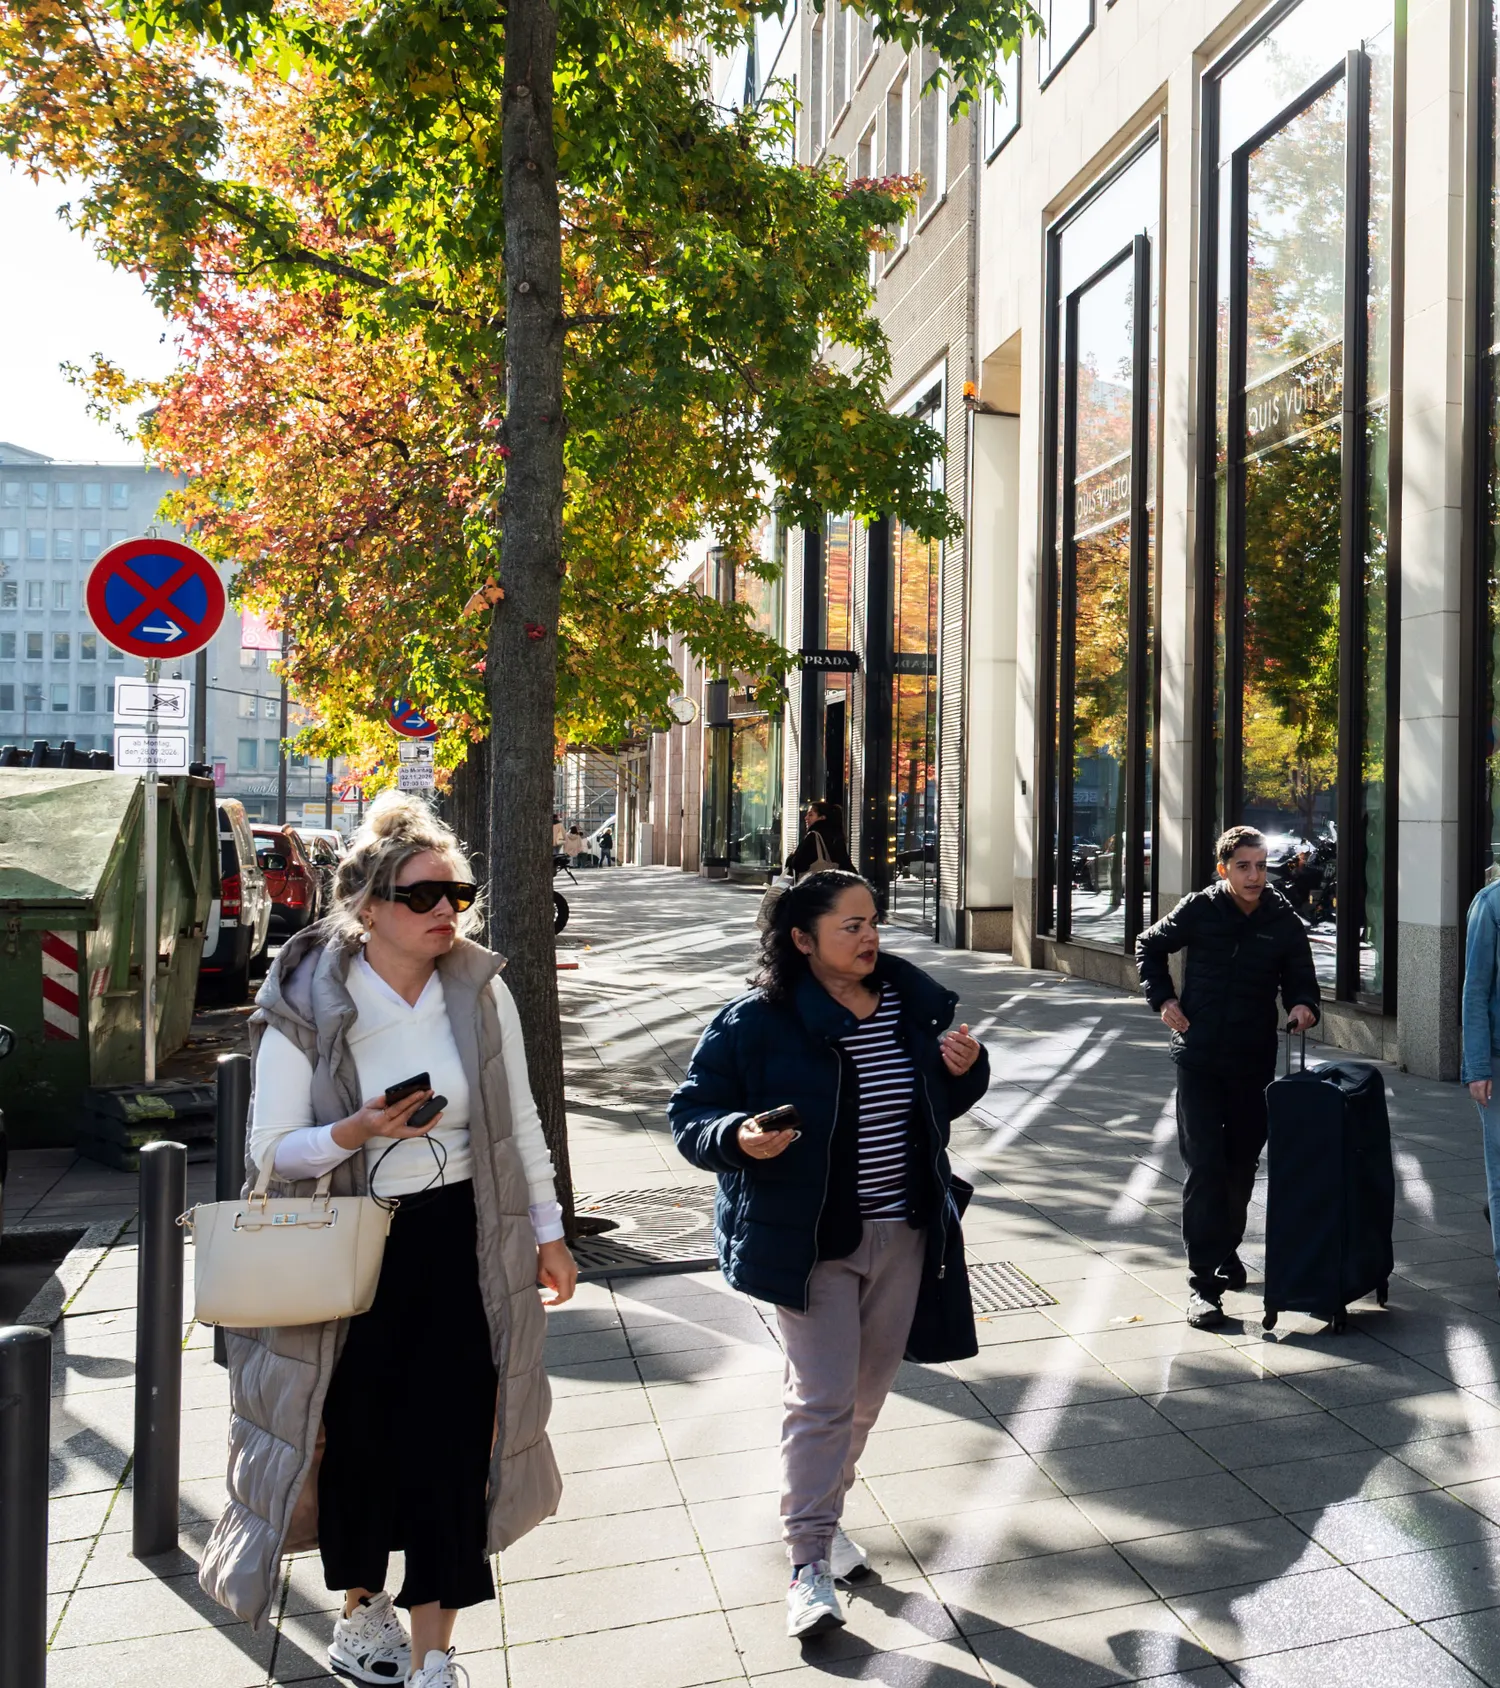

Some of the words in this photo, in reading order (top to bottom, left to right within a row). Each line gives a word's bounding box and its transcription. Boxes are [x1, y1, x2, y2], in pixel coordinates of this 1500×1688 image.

[1248, 396, 1280, 433] OUIS
[1284, 371, 1335, 420] VUITTO
[1076, 490, 1096, 519] OUIS
[804, 654, 850, 666] PRADA
